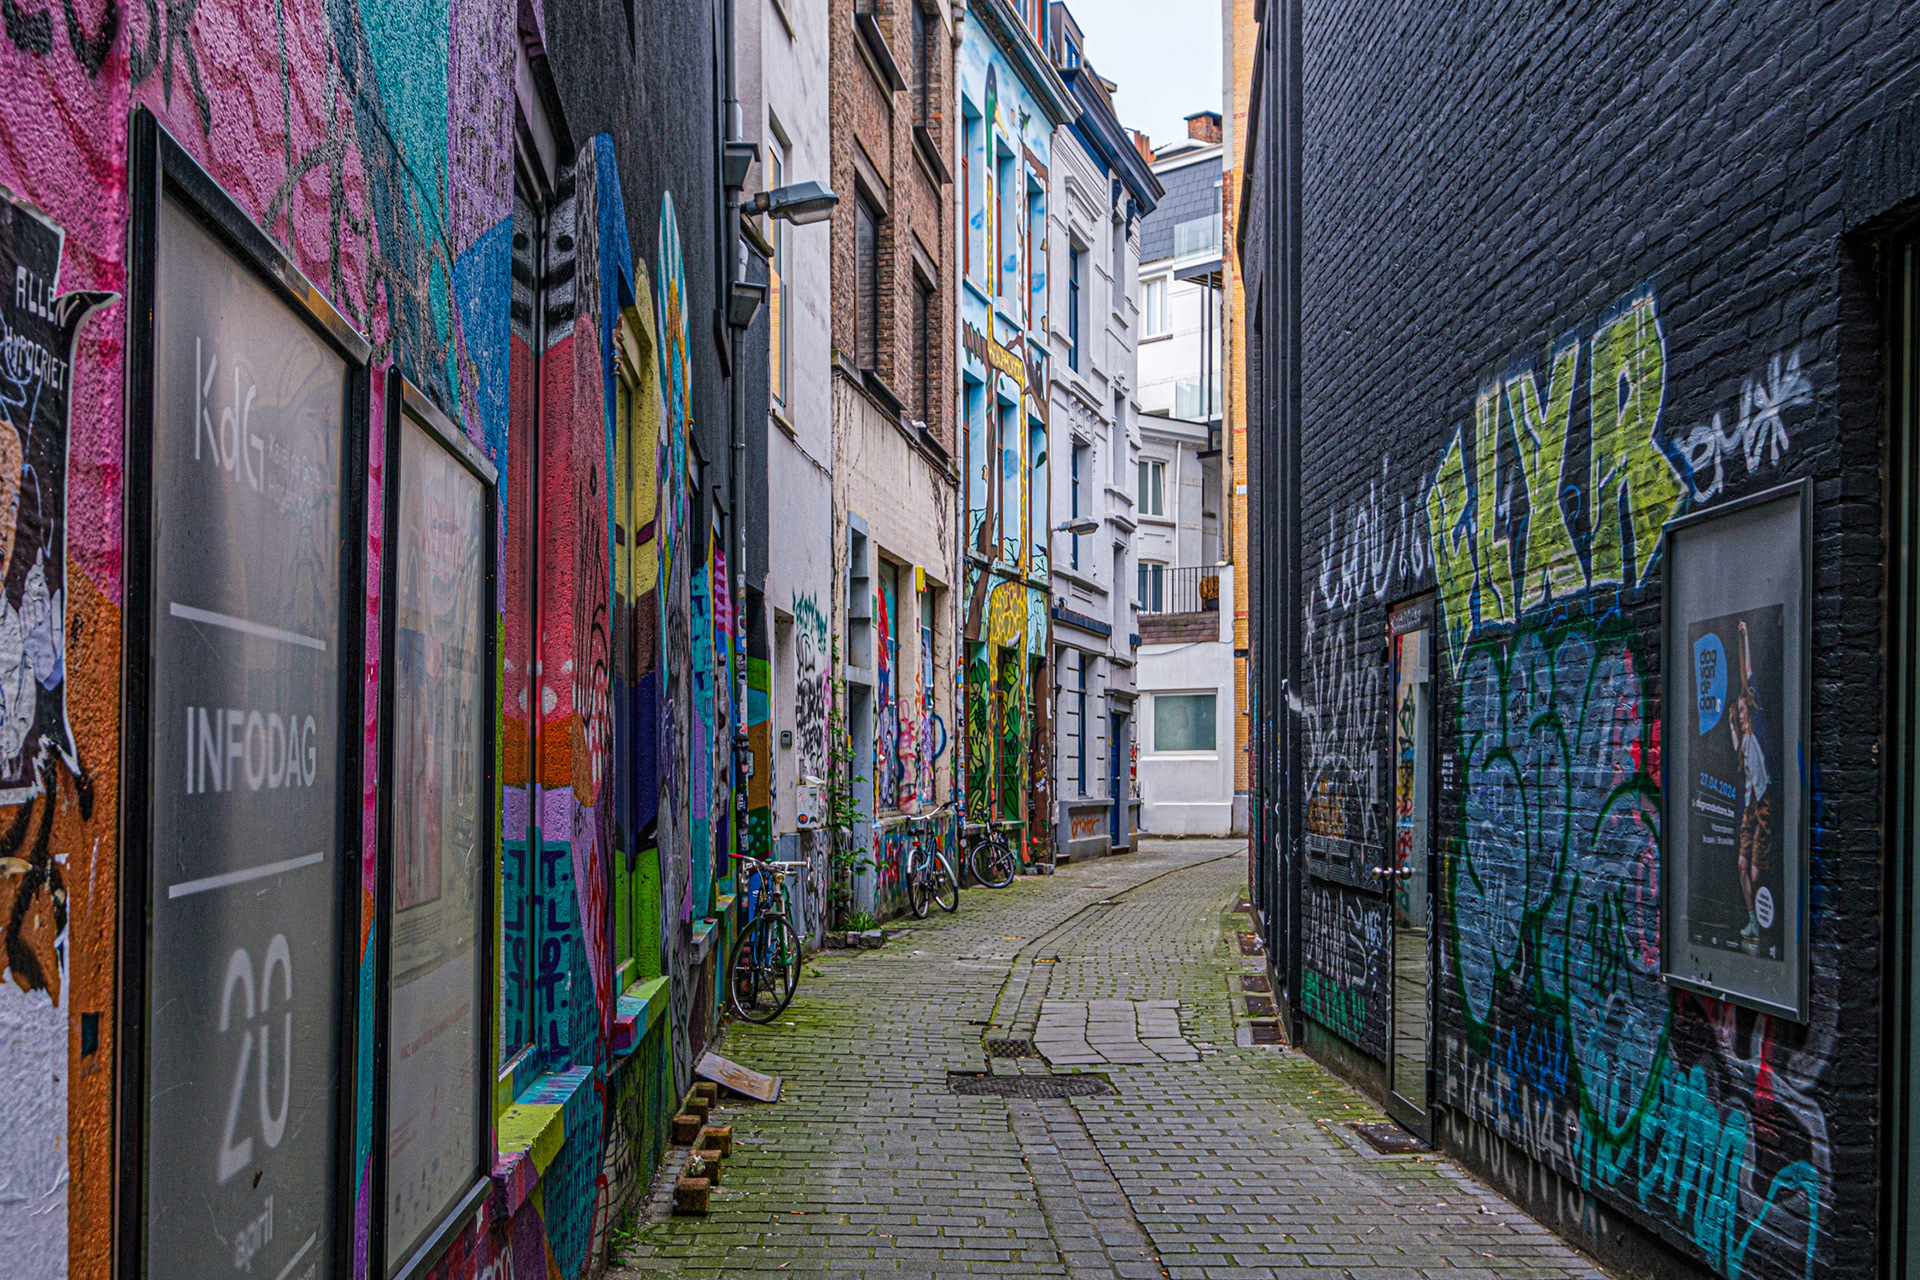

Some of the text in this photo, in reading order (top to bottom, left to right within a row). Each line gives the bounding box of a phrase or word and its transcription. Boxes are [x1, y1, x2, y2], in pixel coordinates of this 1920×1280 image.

[195, 336, 264, 492] KdG
[1700, 649, 1717, 666] dag
[1700, 665, 1715, 680] van
[1700, 695, 1722, 713] dans
[187, 706, 317, 795] INFODAG
[1700, 771, 1737, 800] 27.04.2024
[217, 933, 292, 1183] 20
